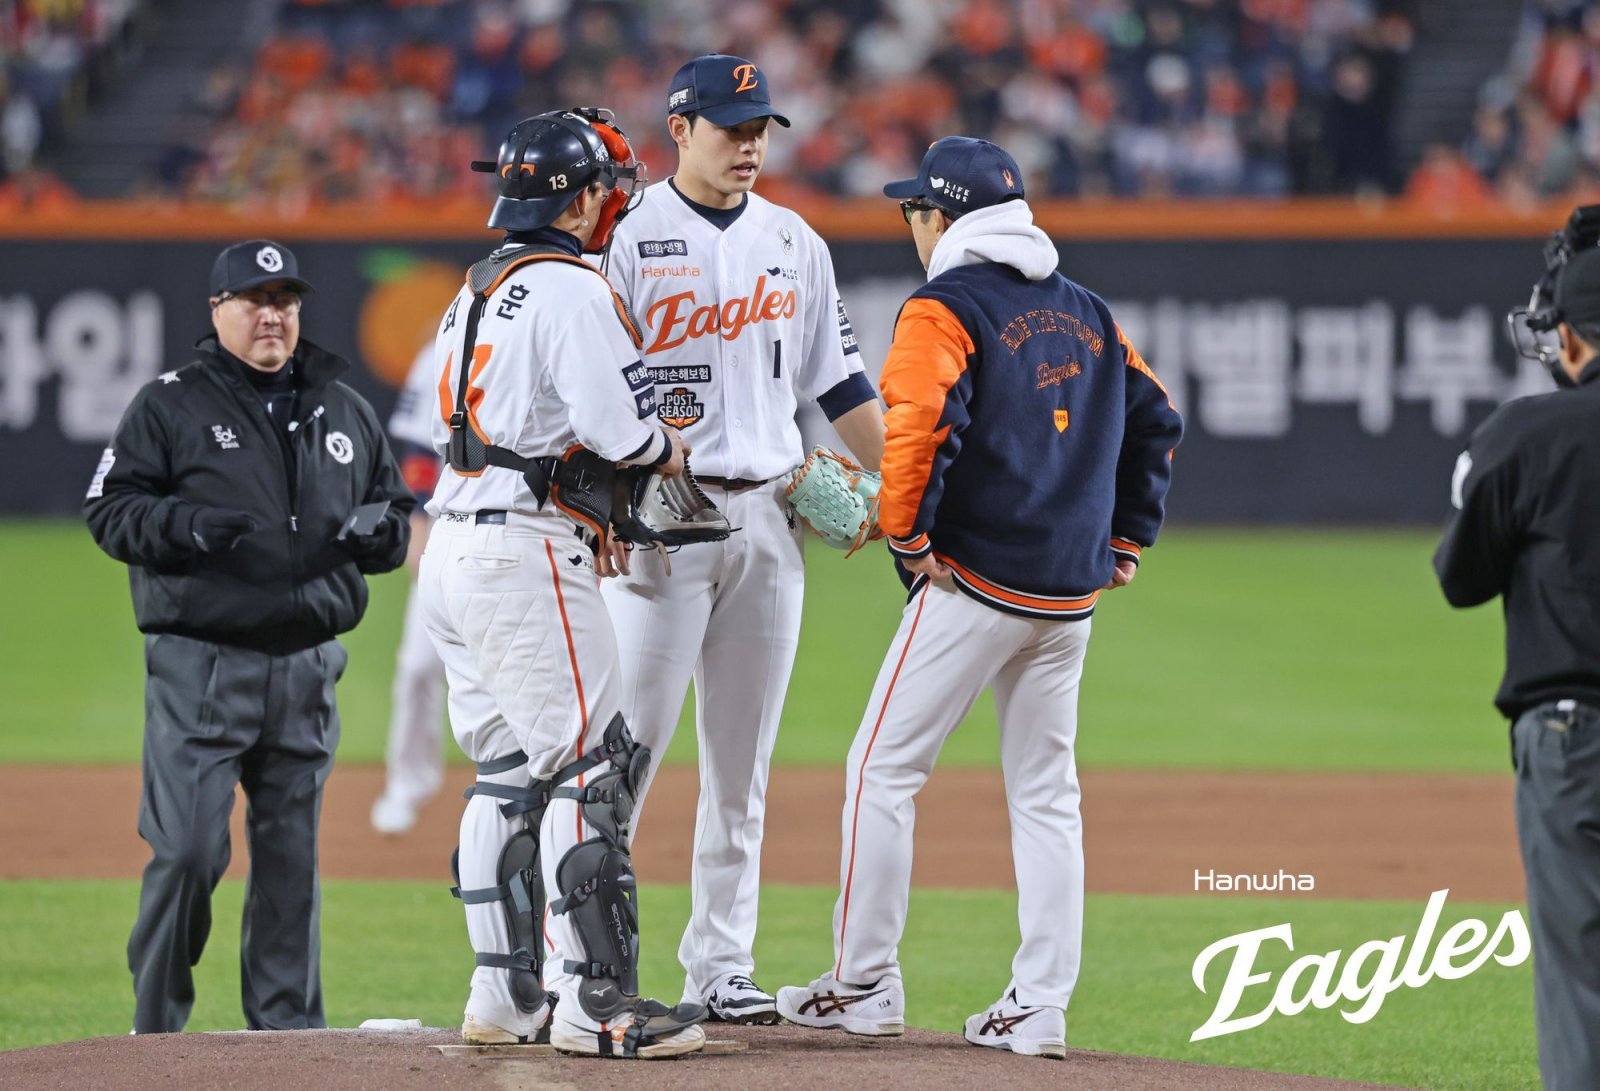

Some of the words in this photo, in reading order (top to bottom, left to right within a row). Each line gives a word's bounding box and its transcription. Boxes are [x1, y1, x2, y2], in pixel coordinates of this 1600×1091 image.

[548, 174, 568, 190] 13
[946, 181, 970, 197] LIFE
[943, 188, 968, 203] PLUS
[644, 241, 684, 255] 한화생명
[642, 265, 700, 279] Hanwha
[443, 284, 530, 334] 최훈
[644, 275, 796, 356] Eagles
[1000, 316, 1033, 355] RIDE
[1026, 309, 1057, 333] THE
[1056, 312, 1104, 357] STORM
[773, 339, 782, 379] 1
[648, 367, 709, 382] 한화손해보험
[1037, 355, 1082, 389] Eagles
[666, 394, 694, 406] POST
[659, 405, 701, 418] SEASON
